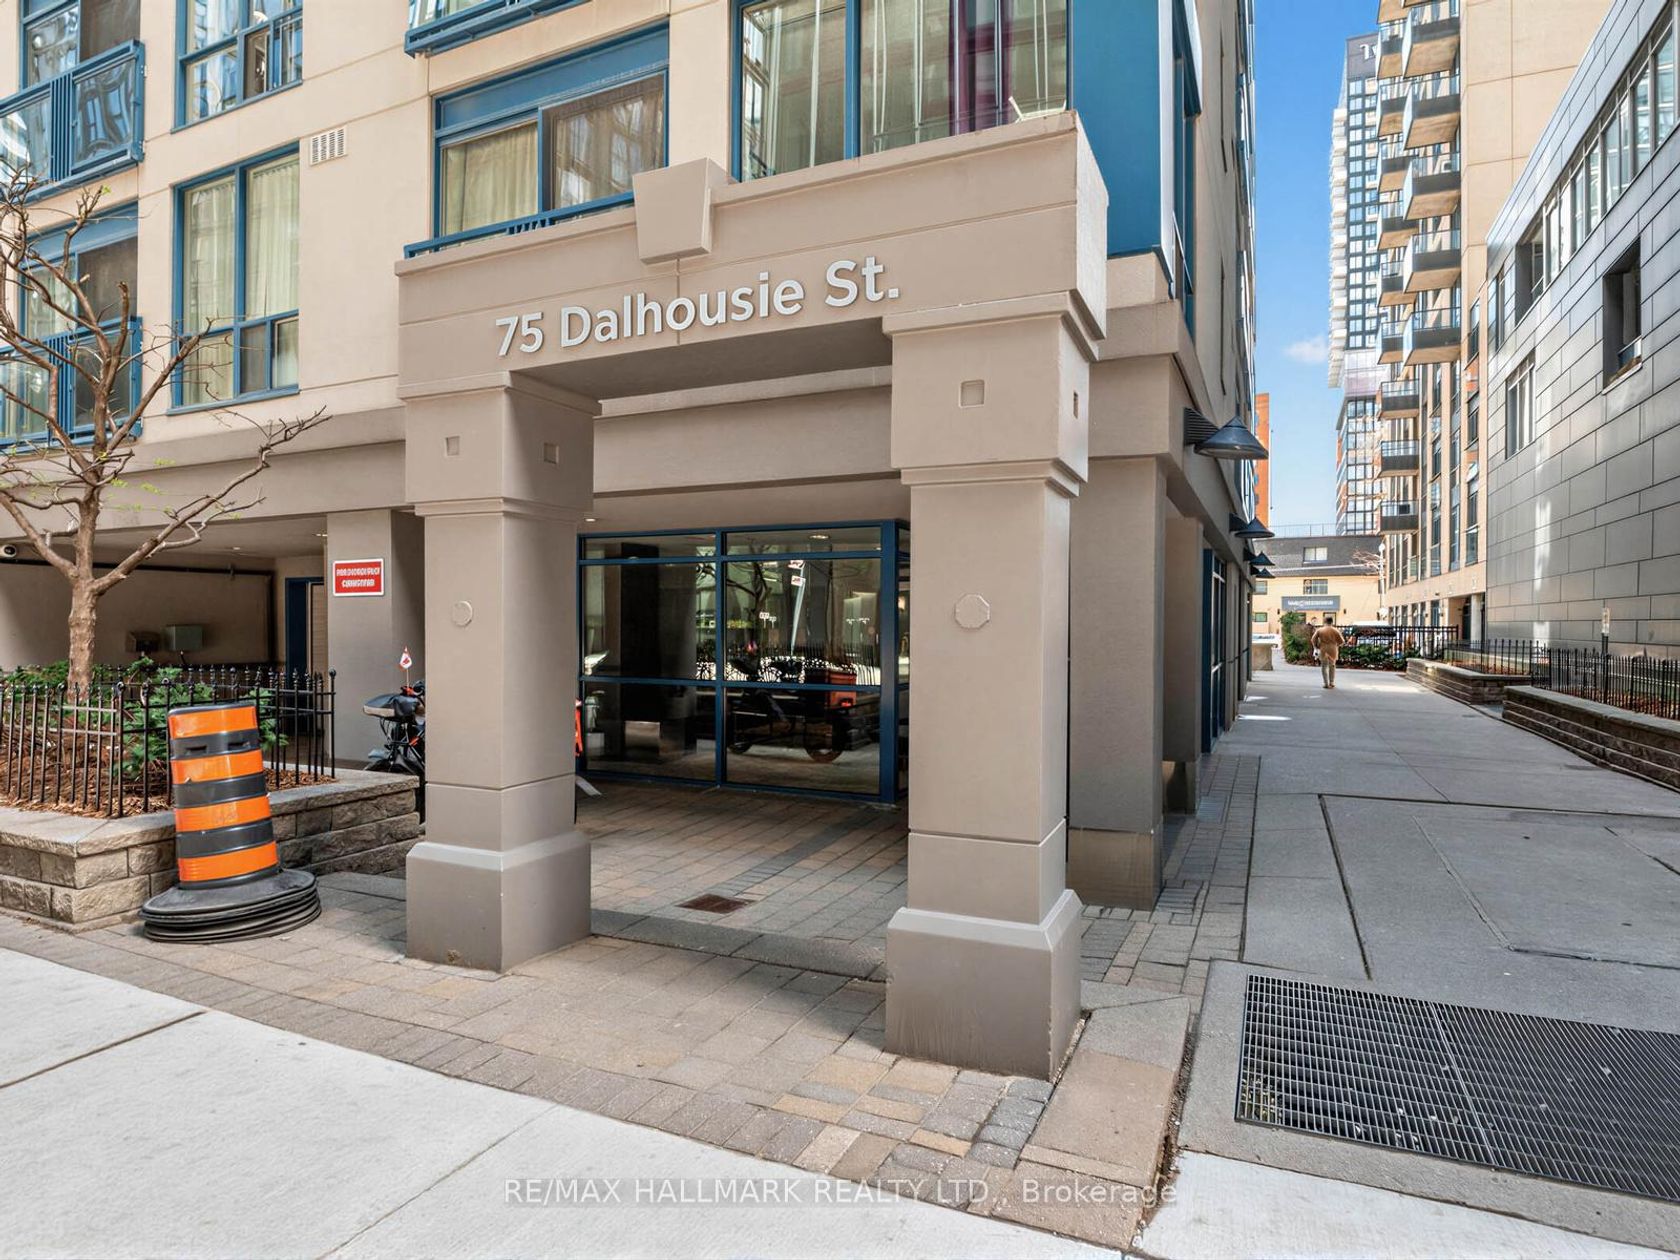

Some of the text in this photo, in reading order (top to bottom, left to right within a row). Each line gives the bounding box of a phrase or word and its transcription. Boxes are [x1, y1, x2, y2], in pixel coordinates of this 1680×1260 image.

[495, 255, 900, 357] 75 Dalhousie St.
